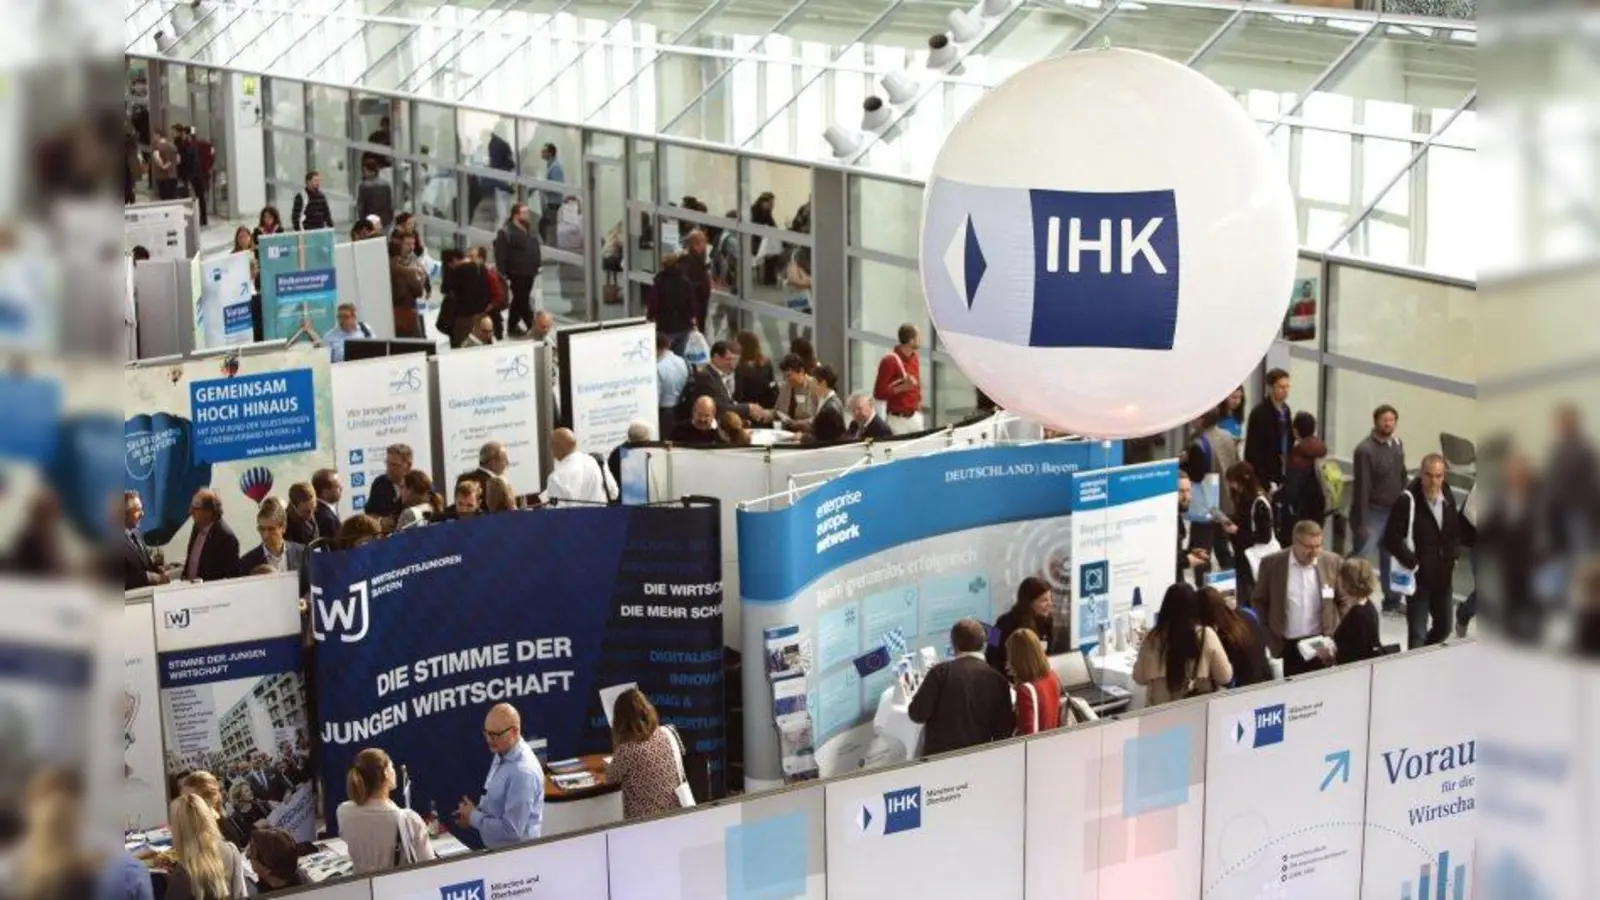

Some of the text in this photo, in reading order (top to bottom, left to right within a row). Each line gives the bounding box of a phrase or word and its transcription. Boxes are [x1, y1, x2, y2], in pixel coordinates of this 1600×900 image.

[1046, 216, 1168, 275] IHK
[195, 378, 287, 403] GEMEINSAM
[197, 396, 299, 423] HOCH HINAUS
[944, 462, 1035, 483] DEUTSCHLAND
[1041, 462, 1078, 476] Bayern
[816, 489, 862, 519] enterprise
[816, 511, 848, 537] europe
[816, 523, 860, 554] network
[907, 546, 978, 575] erfolgreich
[371, 580, 403, 598] BAYERN
[643, 583, 667, 596] DIE
[620, 604, 644, 617] DIE
[647, 606, 688, 619] MEHR
[168, 648, 267, 670] STIMME DER JUNGEN
[376, 636, 573, 698] DIE STIMME DER
[168, 664, 229, 681] WIRTSCHAFT
[321, 670, 575, 745] JUNGEN WIRTSCHAFT
[1257, 710, 1283, 729] IHK
[1381, 739, 1476, 785] Vorau
[1441, 774, 1475, 795] für die
[887, 793, 918, 814] IHK
[1408, 796, 1475, 827] Wirtscha
[526, 874, 540, 884] und
[446, 886, 481, 900] IHK
